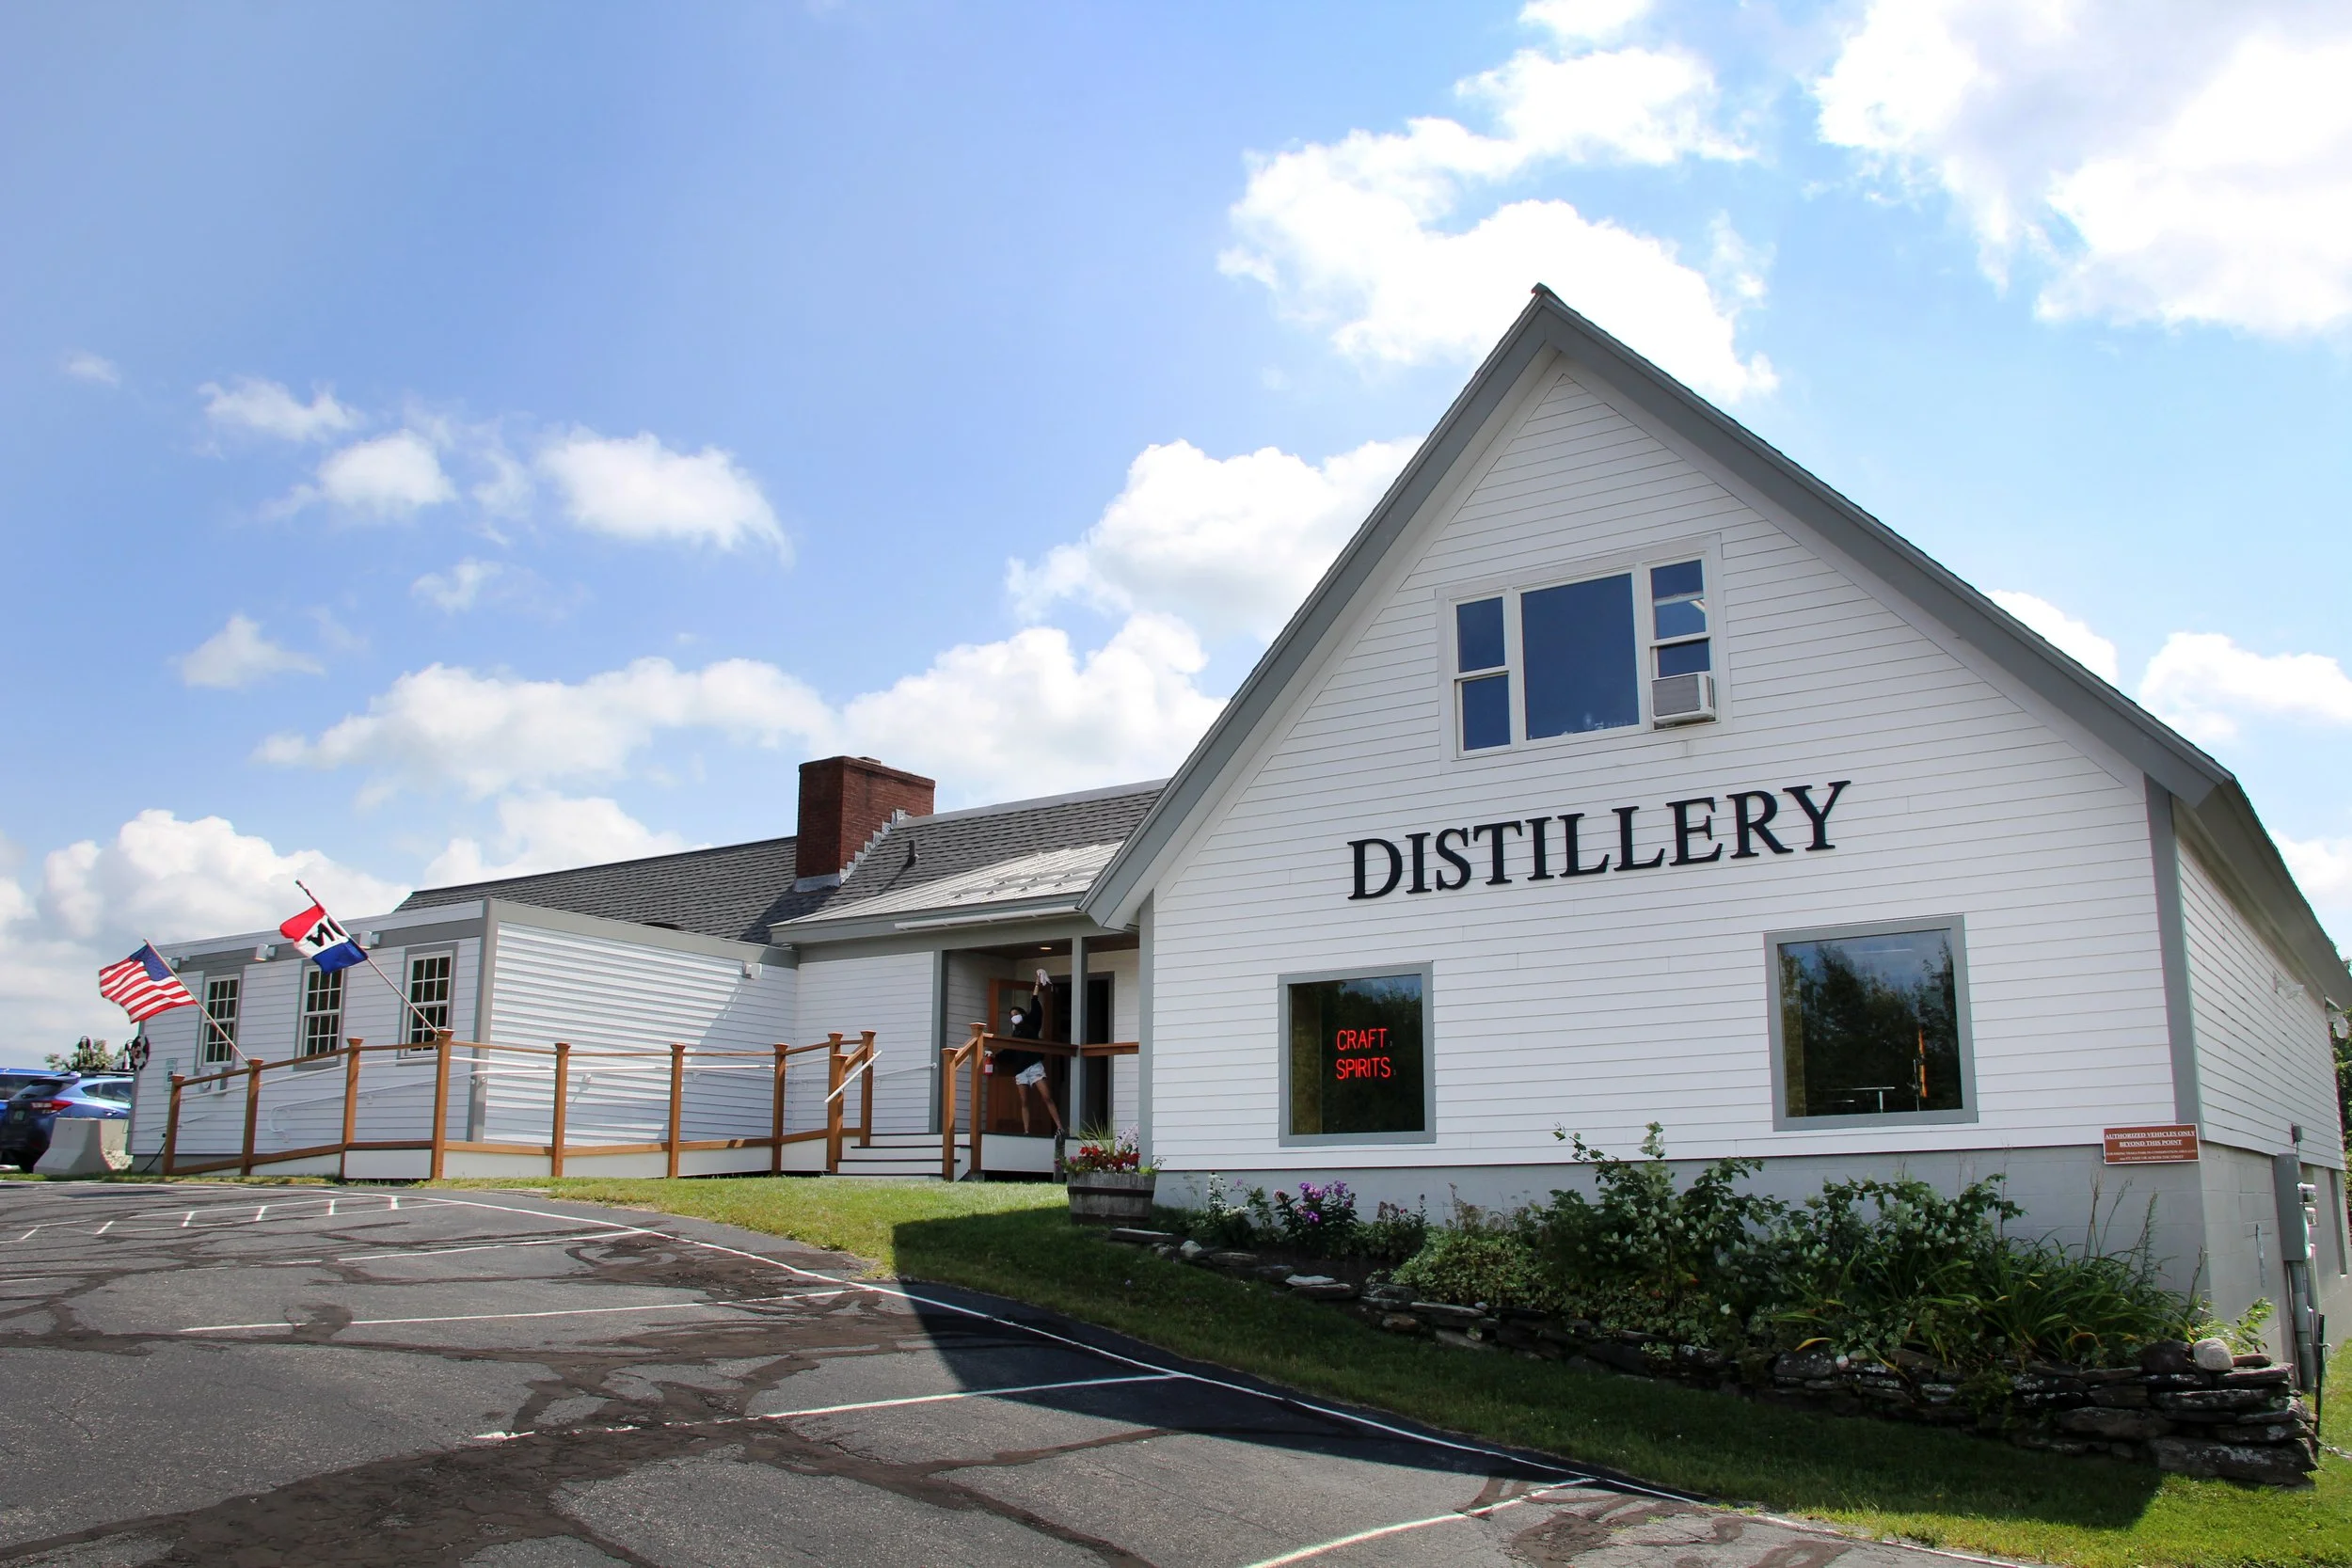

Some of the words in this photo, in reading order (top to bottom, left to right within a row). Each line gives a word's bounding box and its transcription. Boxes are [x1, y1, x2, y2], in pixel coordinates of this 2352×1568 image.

[1347, 781, 1851, 900] DISTILLERY
[1336, 1028, 1388, 1051] CRAFT
[1336, 1056, 1391, 1080] SPIRITS
